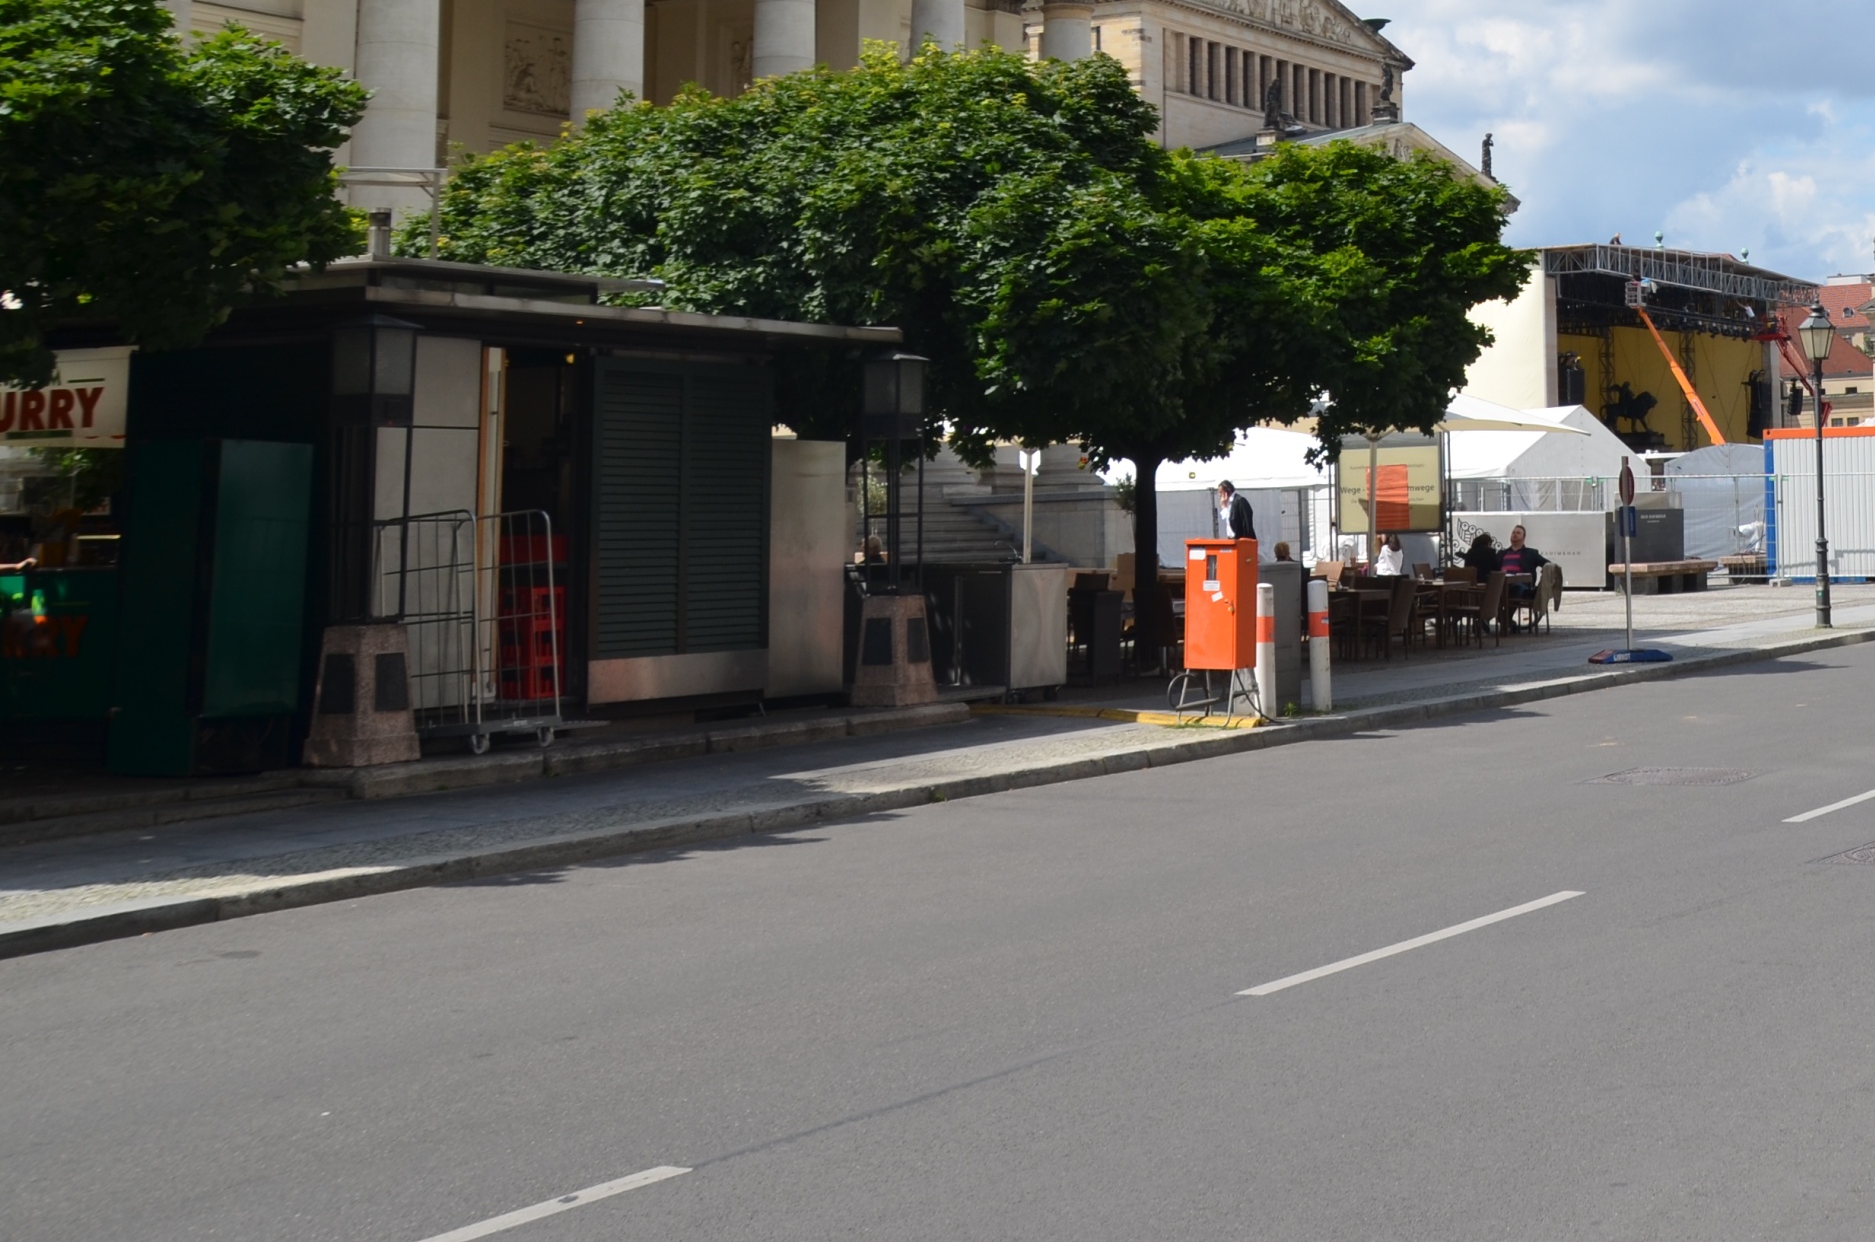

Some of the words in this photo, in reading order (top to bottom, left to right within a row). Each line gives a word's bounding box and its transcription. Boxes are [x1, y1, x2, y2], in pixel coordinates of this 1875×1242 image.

[0, 387, 104, 433] URRY
[1340, 486, 1361, 495] Wege
[1407, 483, 1435, 493] mwege
